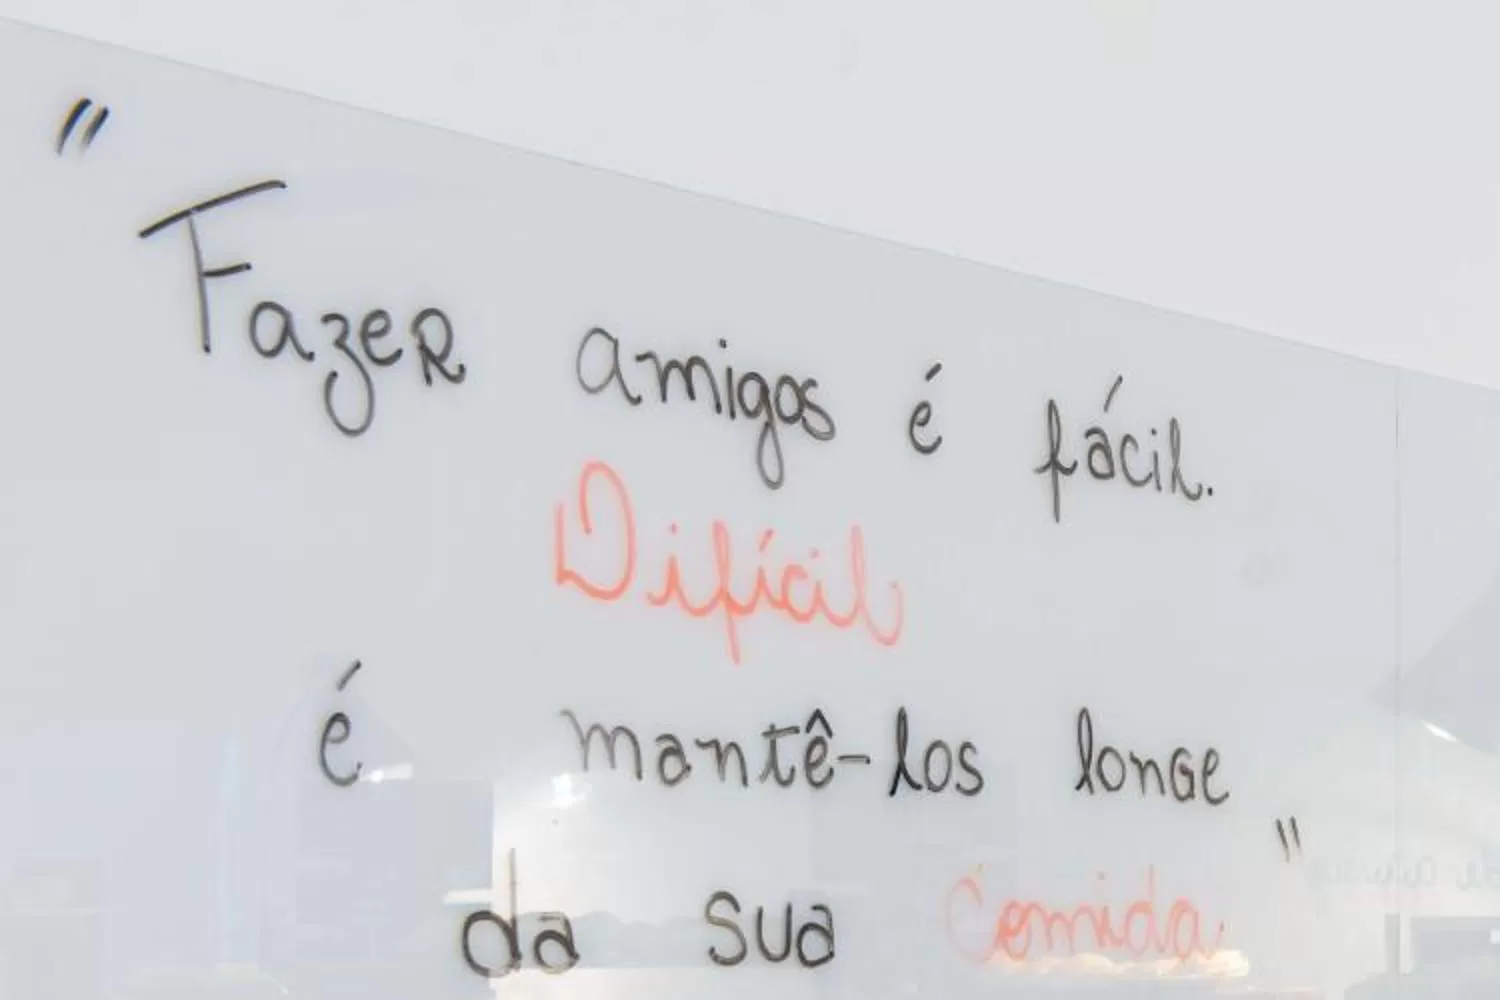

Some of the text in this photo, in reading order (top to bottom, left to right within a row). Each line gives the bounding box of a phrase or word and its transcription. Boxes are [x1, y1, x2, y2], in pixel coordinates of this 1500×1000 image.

[575, 326, 837, 490] amigos
[908, 363, 943, 454] é
[1033, 375, 1215, 522] fácil.
[554, 460, 904, 665] Difícil
[318, 660, 362, 788] é
[560, 706, 986, 798] mantê-los
[461, 848, 581, 978] da
